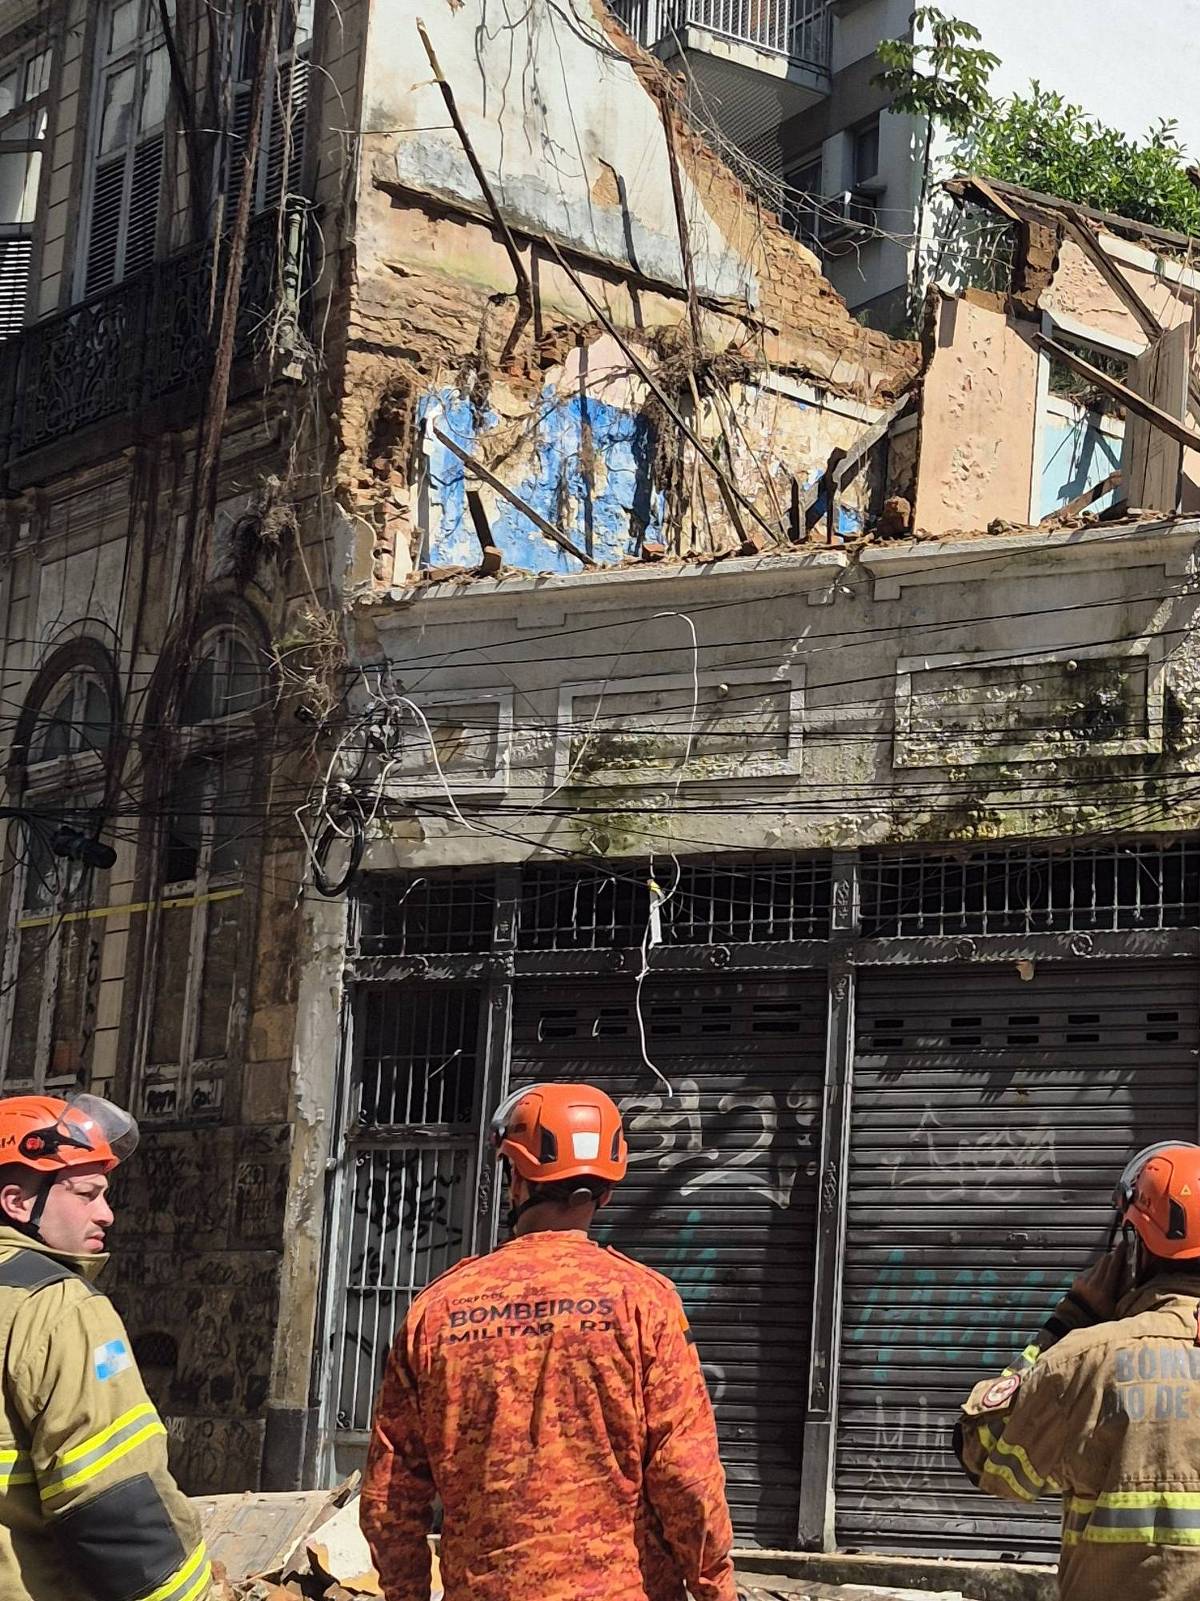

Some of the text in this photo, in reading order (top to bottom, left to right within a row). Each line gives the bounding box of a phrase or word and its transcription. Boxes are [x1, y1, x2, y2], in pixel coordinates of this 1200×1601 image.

[450, 1298, 613, 1328] BOMBEIROS
[449, 1321, 555, 1344] MILITAR
[580, 1319, 612, 1332] RJ
[1156, 1384, 1190, 1420] DE
